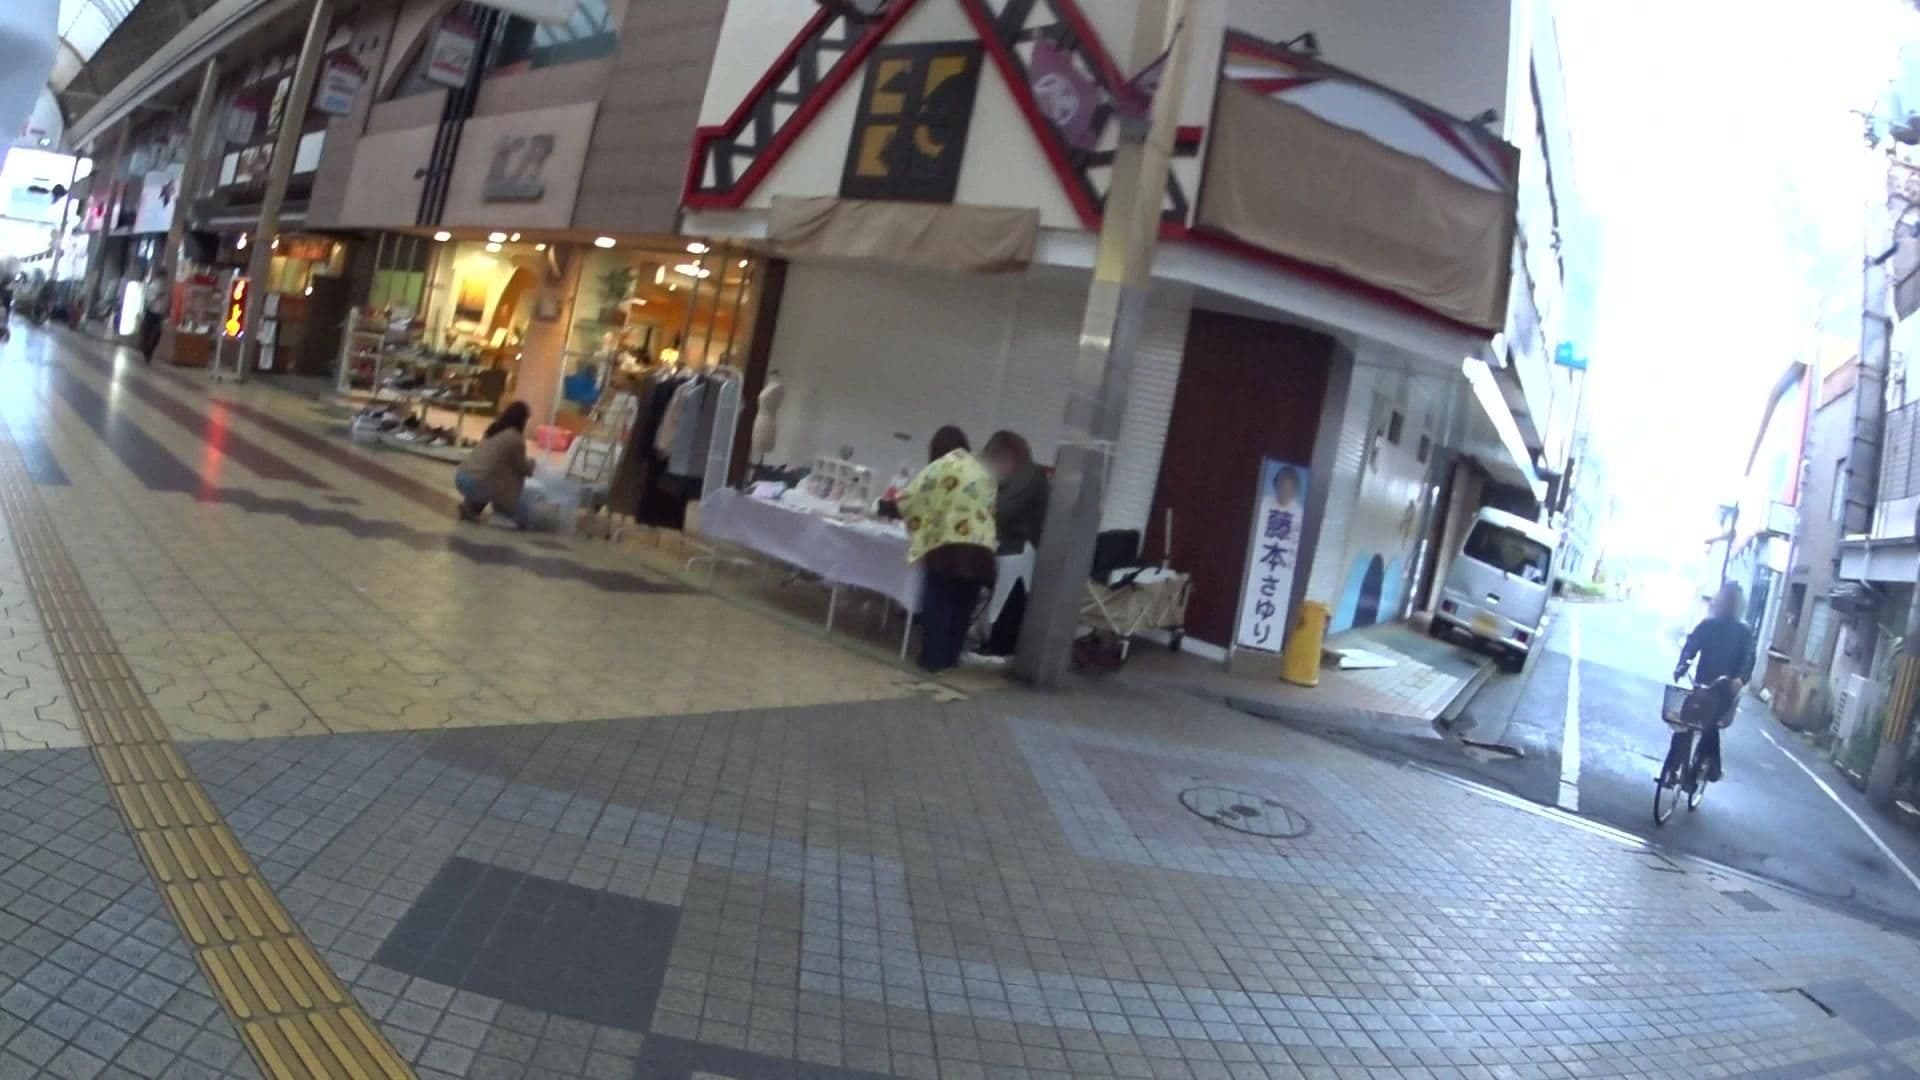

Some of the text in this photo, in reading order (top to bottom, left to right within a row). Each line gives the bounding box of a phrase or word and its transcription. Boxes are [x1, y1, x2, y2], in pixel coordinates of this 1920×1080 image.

[1253, 509, 1294, 644] 藤本さゆり
